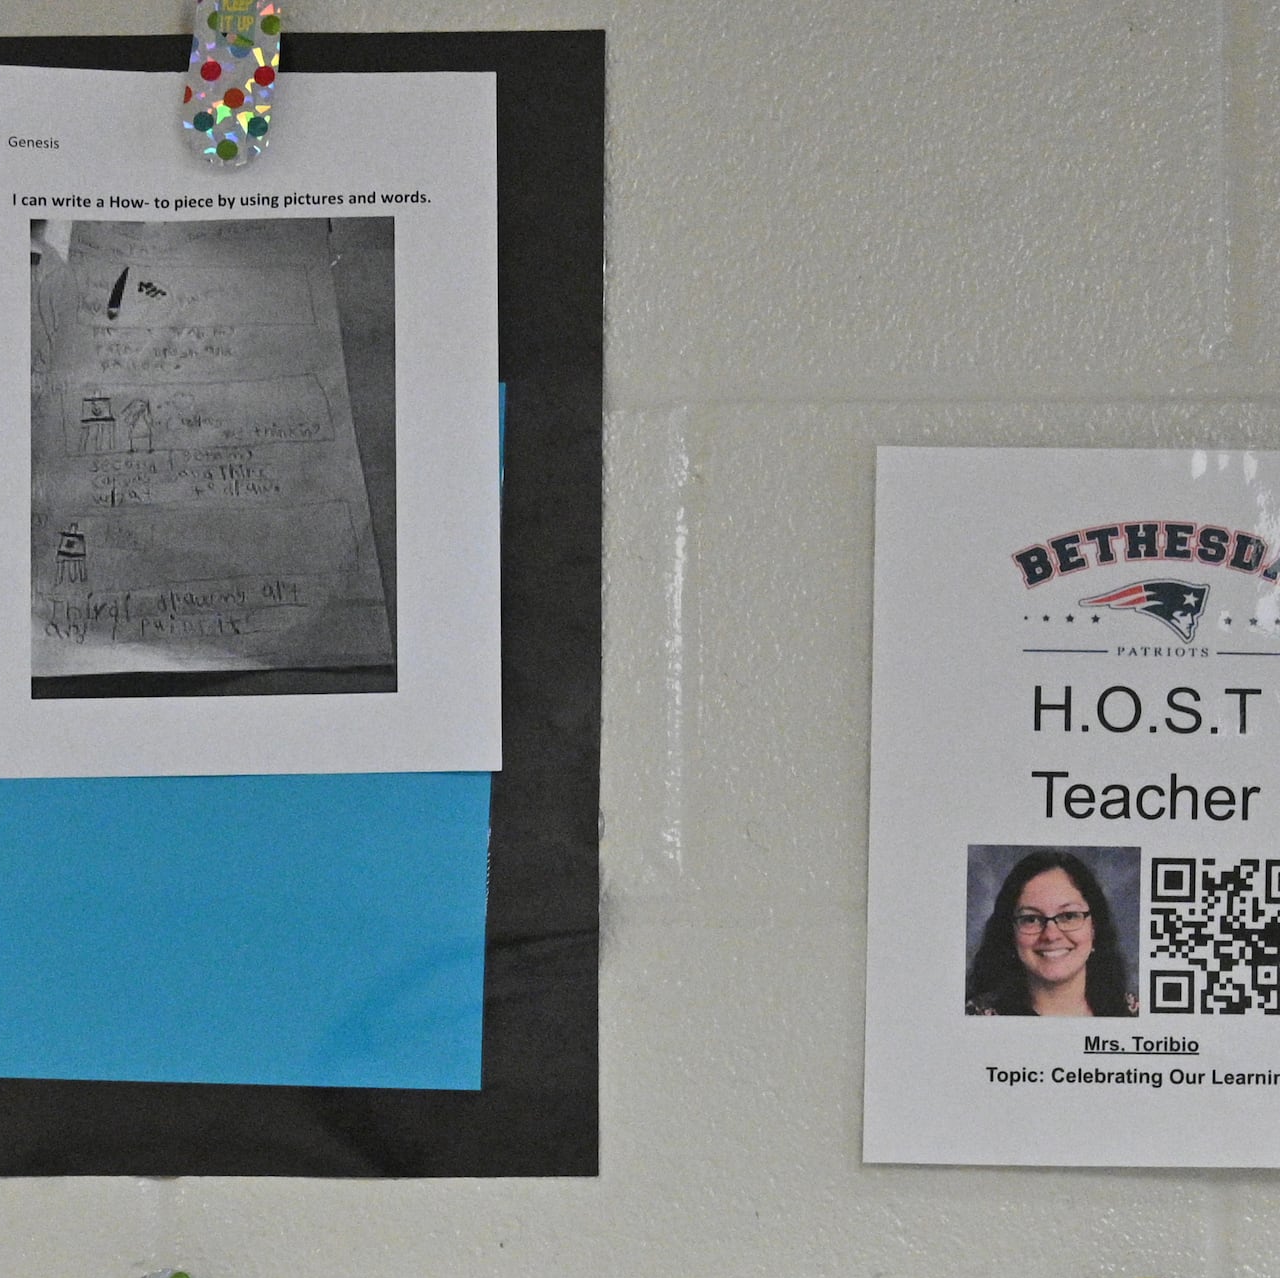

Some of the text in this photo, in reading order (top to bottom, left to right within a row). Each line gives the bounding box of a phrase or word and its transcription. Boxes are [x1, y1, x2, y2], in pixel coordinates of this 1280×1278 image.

[9, 136, 59, 149] Genesis
[13, 191, 430, 211] I can write a How- to piece by using pictures and words.
[1118, 647, 1208, 657] PATRIOTS
[1034, 686, 1262, 734] H.O.S.T
[1032, 771, 1260, 821] Teacher
[1084, 1036, 1199, 1055] Mrs. Toribio
[986, 1067, 1043, 1086] Topic:
[1052, 1068, 1162, 1088] Celebrating
[1170, 1069, 1205, 1084] Our
